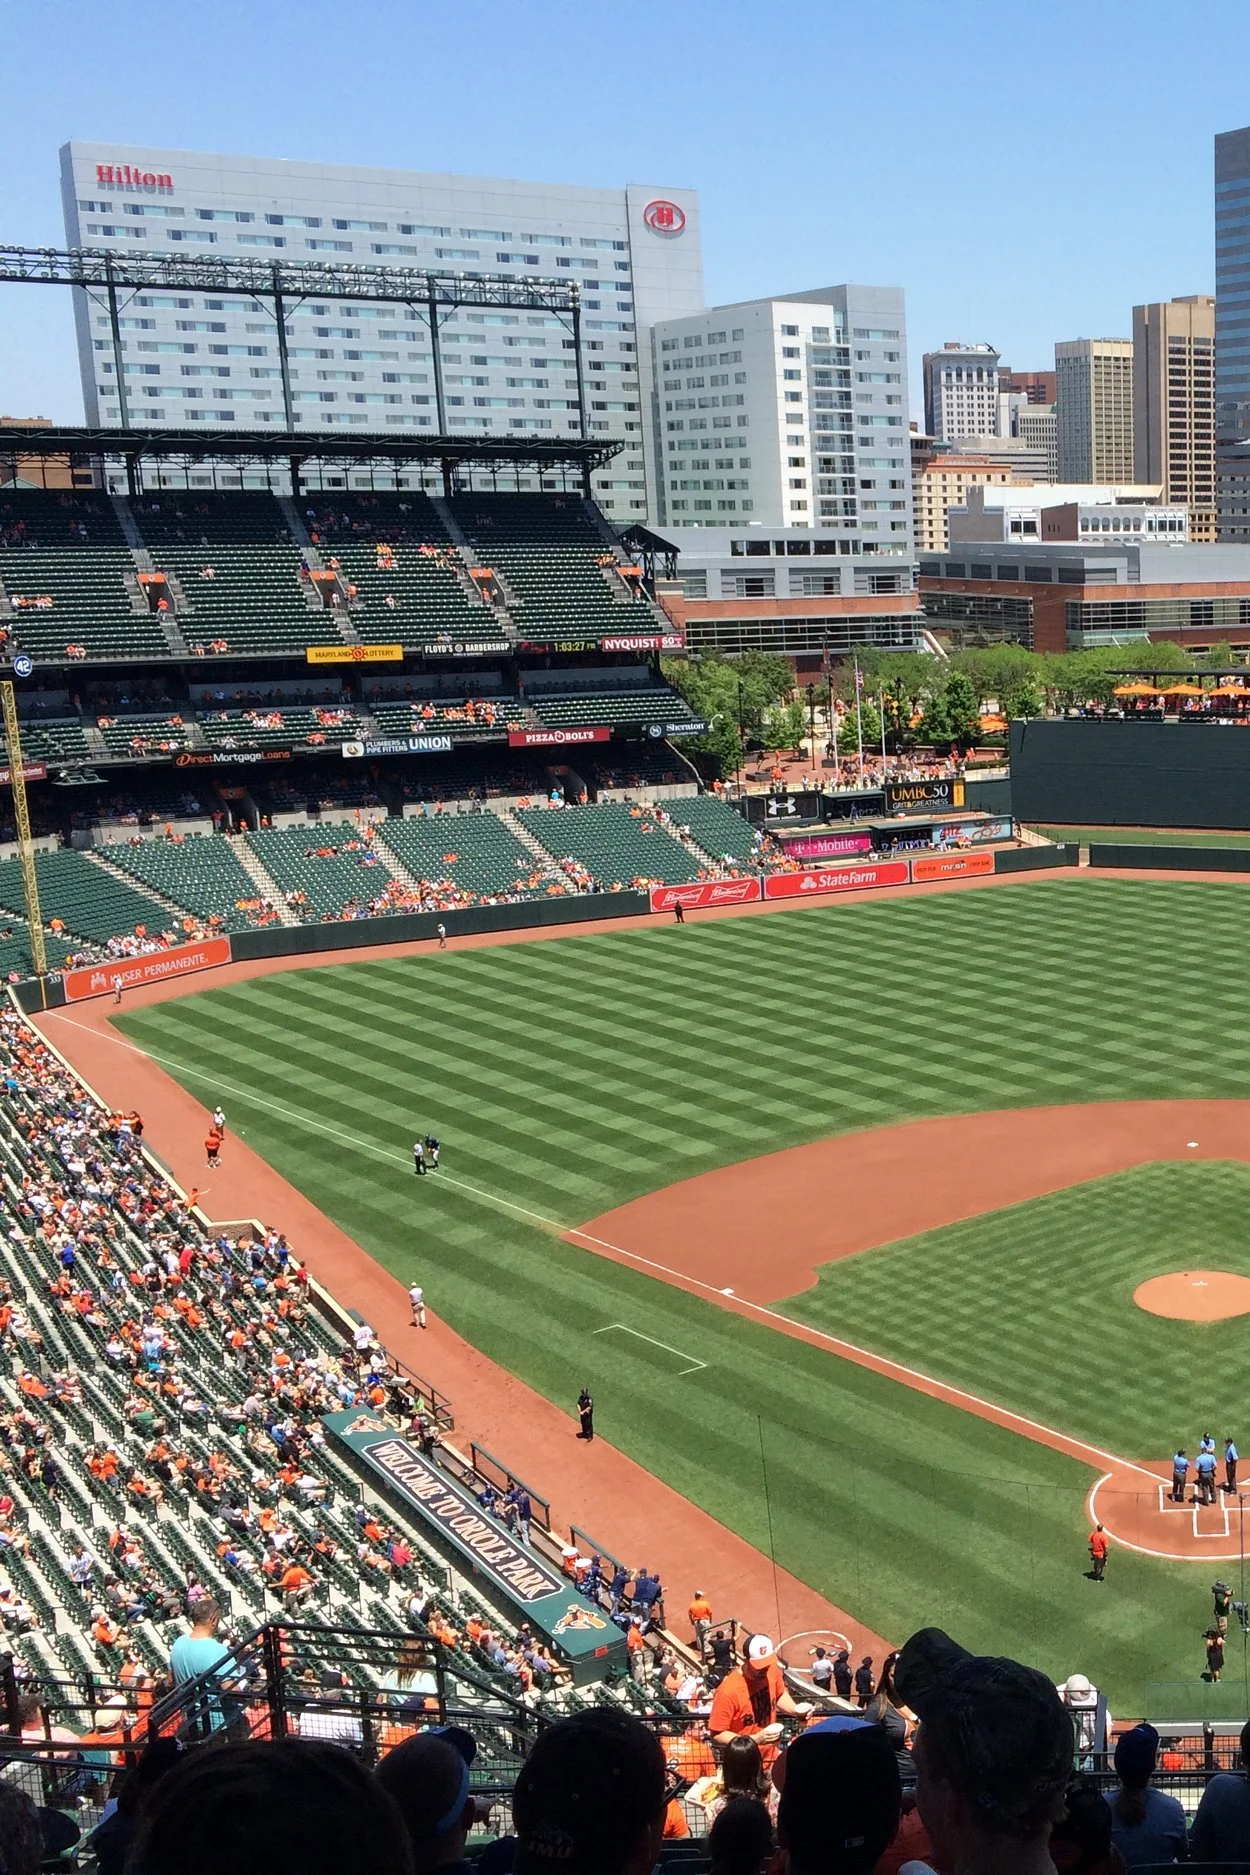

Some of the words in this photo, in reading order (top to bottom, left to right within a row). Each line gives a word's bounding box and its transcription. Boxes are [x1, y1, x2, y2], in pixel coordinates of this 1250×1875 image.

[96, 164, 174, 187] Hilton
[424, 644, 453, 654] FLOYD'S
[465, 642, 510, 652] BARBERSHOP
[553, 641, 585, 652] 1:03:27
[605, 638, 656, 650] NYQUIST
[661, 636, 675, 645] 60
[315, 650, 351, 658] MARYLAND
[16, 660, 30, 673] 42
[366, 740, 398, 748] PLUMBERS
[408, 736, 451, 750] UNION
[526, 734, 554, 743] PIZZA
[565, 731, 594, 741] BOLI'S
[366, 746, 381, 754] PIPE
[382, 744, 408, 753] FITTERS
[891, 783, 949, 801] UMBC50
[144, 953, 206, 978] PERMANENTE
[372, 1441, 446, 1502] WELCOME
[429, 1494, 465, 1518] TO
[449, 1513, 518, 1565] ORIOLE
[496, 1553, 556, 1598] PARK
